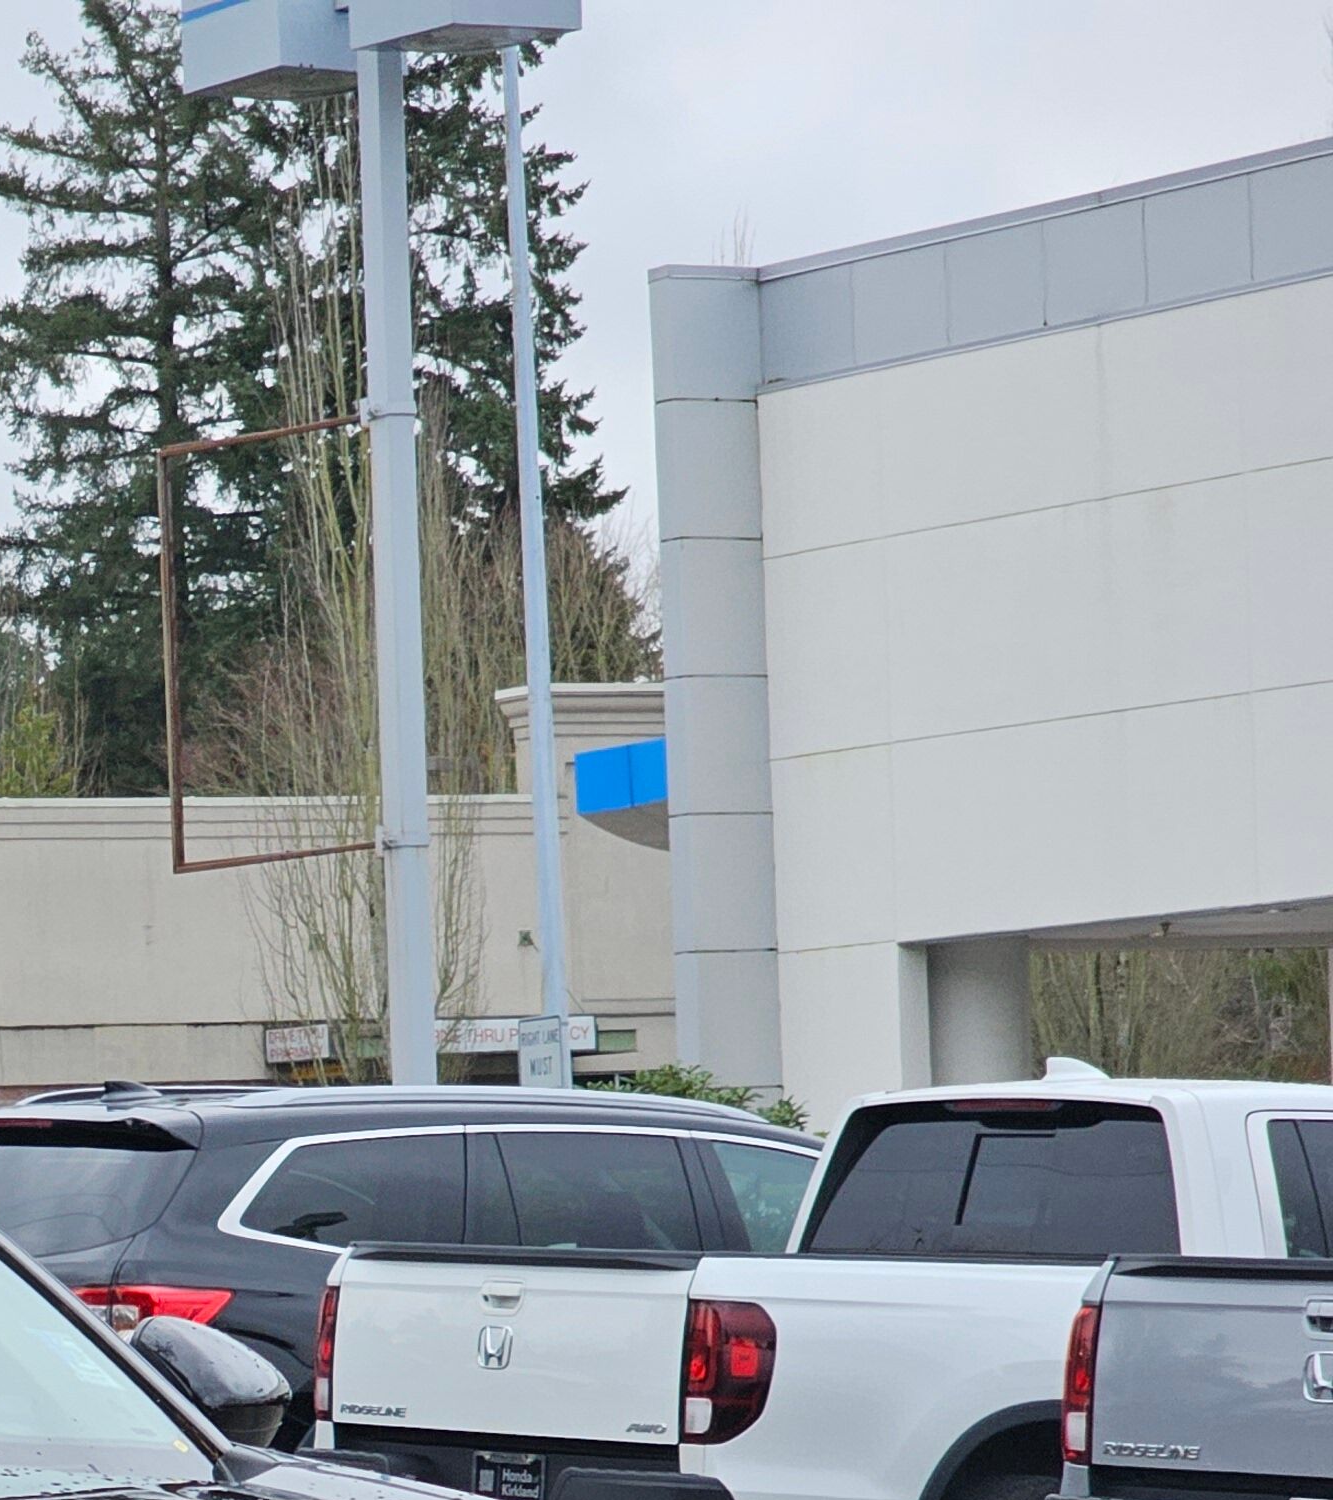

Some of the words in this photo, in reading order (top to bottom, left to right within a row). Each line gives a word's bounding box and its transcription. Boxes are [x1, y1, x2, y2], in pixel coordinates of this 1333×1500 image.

[340, 1403, 407, 1418] RIDGELINE
[1103, 1441, 1200, 1460] RIDGELINE
[502, 1468, 532, 1483] Honda
